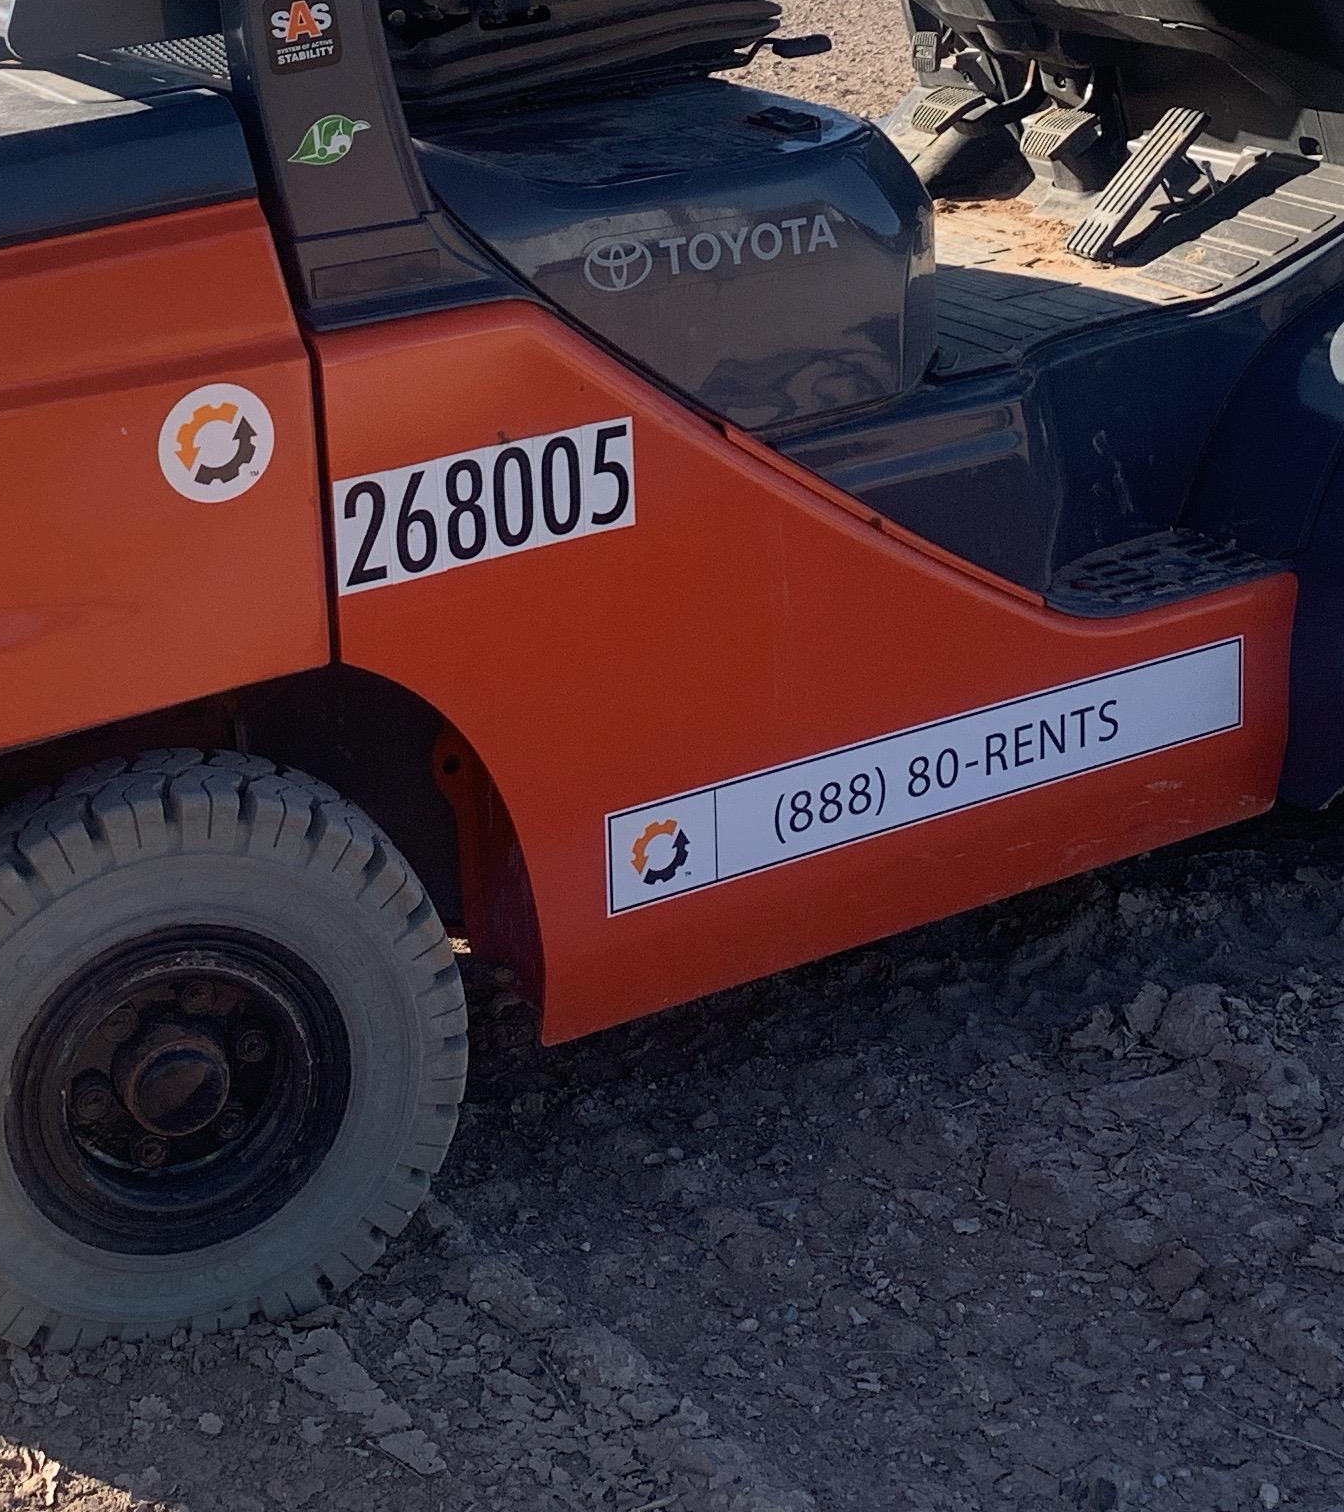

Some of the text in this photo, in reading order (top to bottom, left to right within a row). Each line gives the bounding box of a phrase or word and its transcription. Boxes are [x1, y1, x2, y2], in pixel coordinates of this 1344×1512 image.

[271, 0, 333, 44] SAS
[276, 45, 302, 55] SYSTEM
[277, 46, 334, 65] STABILITY
[658, 214, 839, 276] TOYOTA
[343, 423, 631, 588] 268005
[773, 698, 1120, 844] (888) 80-RENTS
